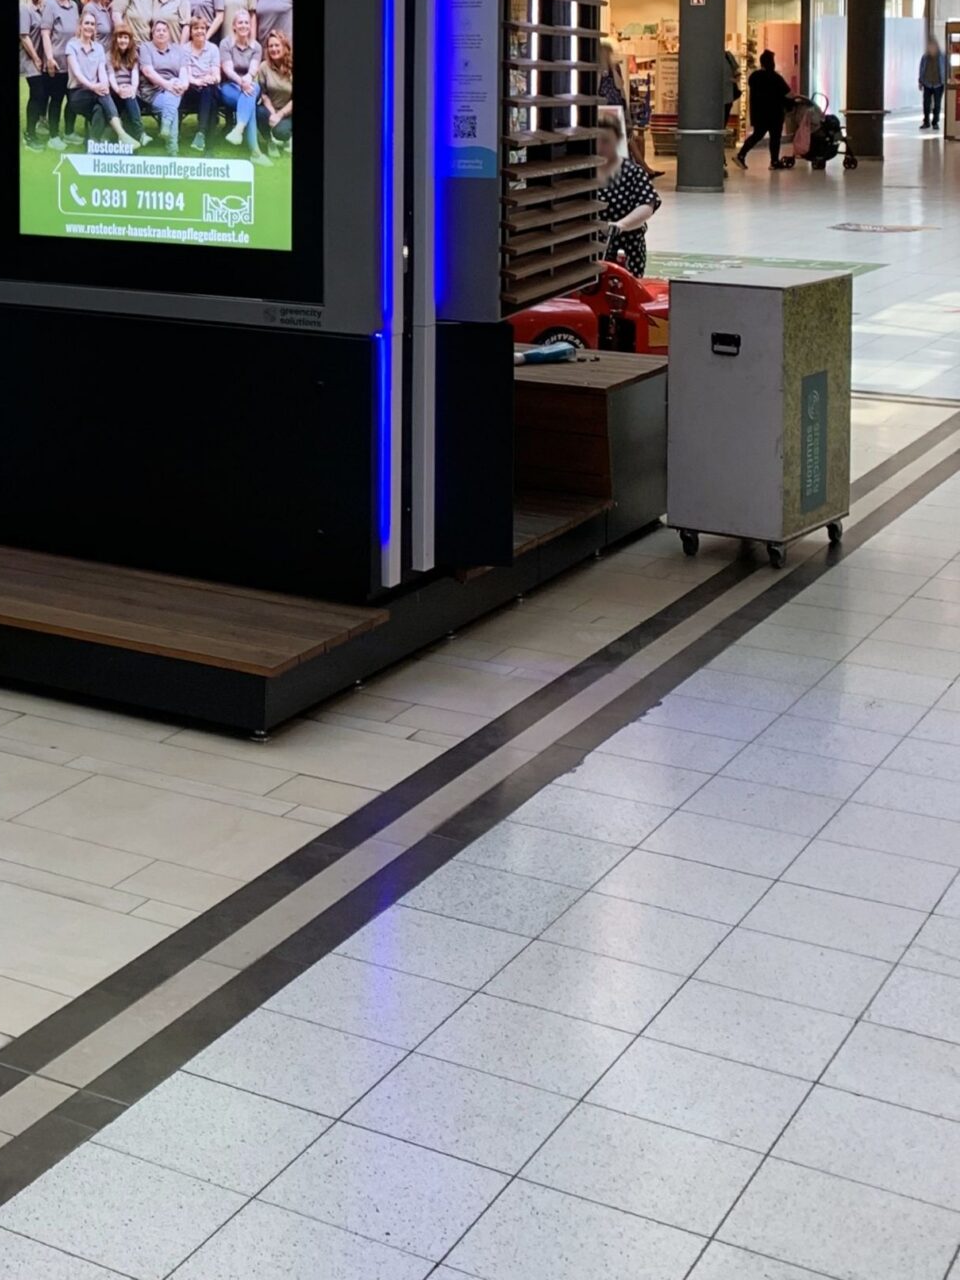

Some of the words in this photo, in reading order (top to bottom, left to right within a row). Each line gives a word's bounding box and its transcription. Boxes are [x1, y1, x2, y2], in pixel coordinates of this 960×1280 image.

[88, 140, 134, 154] Rostocker
[93, 158, 230, 179] Hauskrankenpflegedienst
[91, 190, 127, 209] 0381
[136, 191, 185, 211] 711194
[66, 222, 249, 243] www.rostocker-hauskrankenpflegedienst.de
